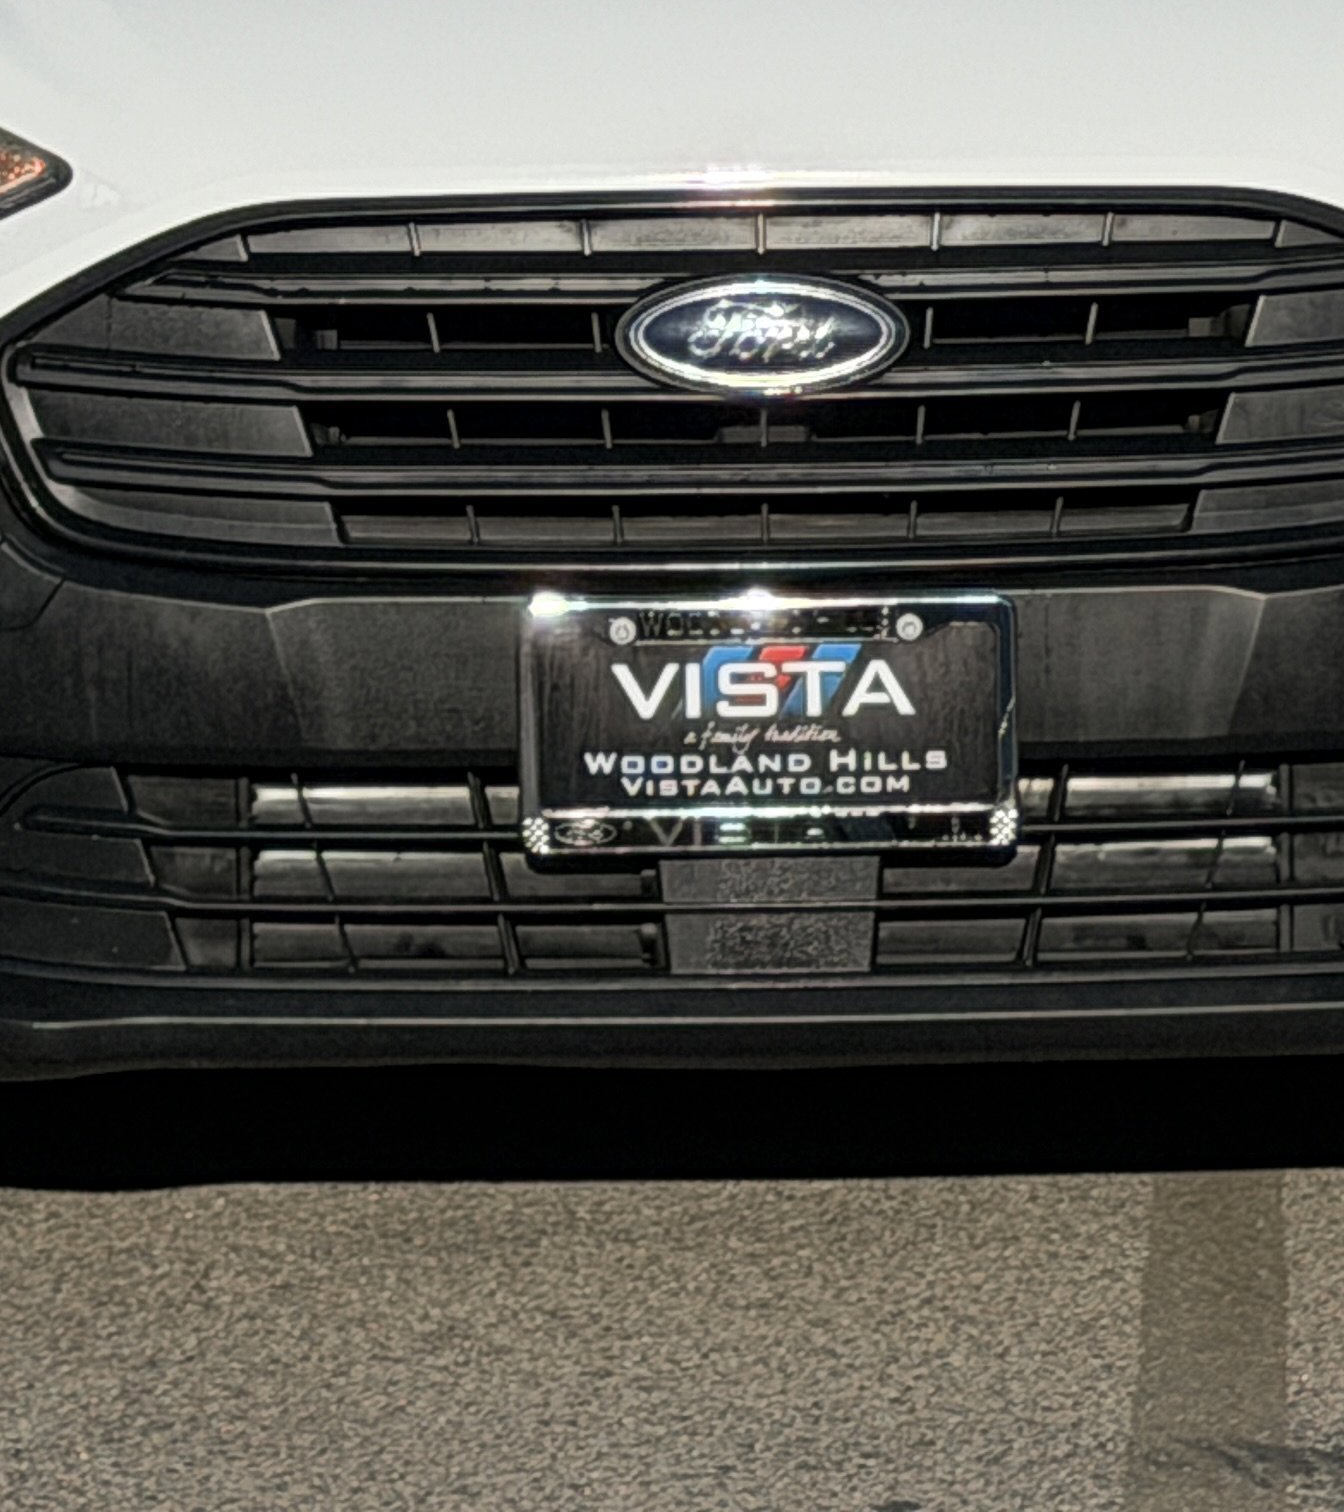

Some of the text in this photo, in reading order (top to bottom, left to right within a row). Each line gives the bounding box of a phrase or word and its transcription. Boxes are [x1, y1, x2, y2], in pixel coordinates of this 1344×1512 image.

[610, 658, 918, 720] VISTA
[584, 748, 949, 776] WOODLAND HILLS
[621, 773, 911, 798] VISTAAUTO.COM
